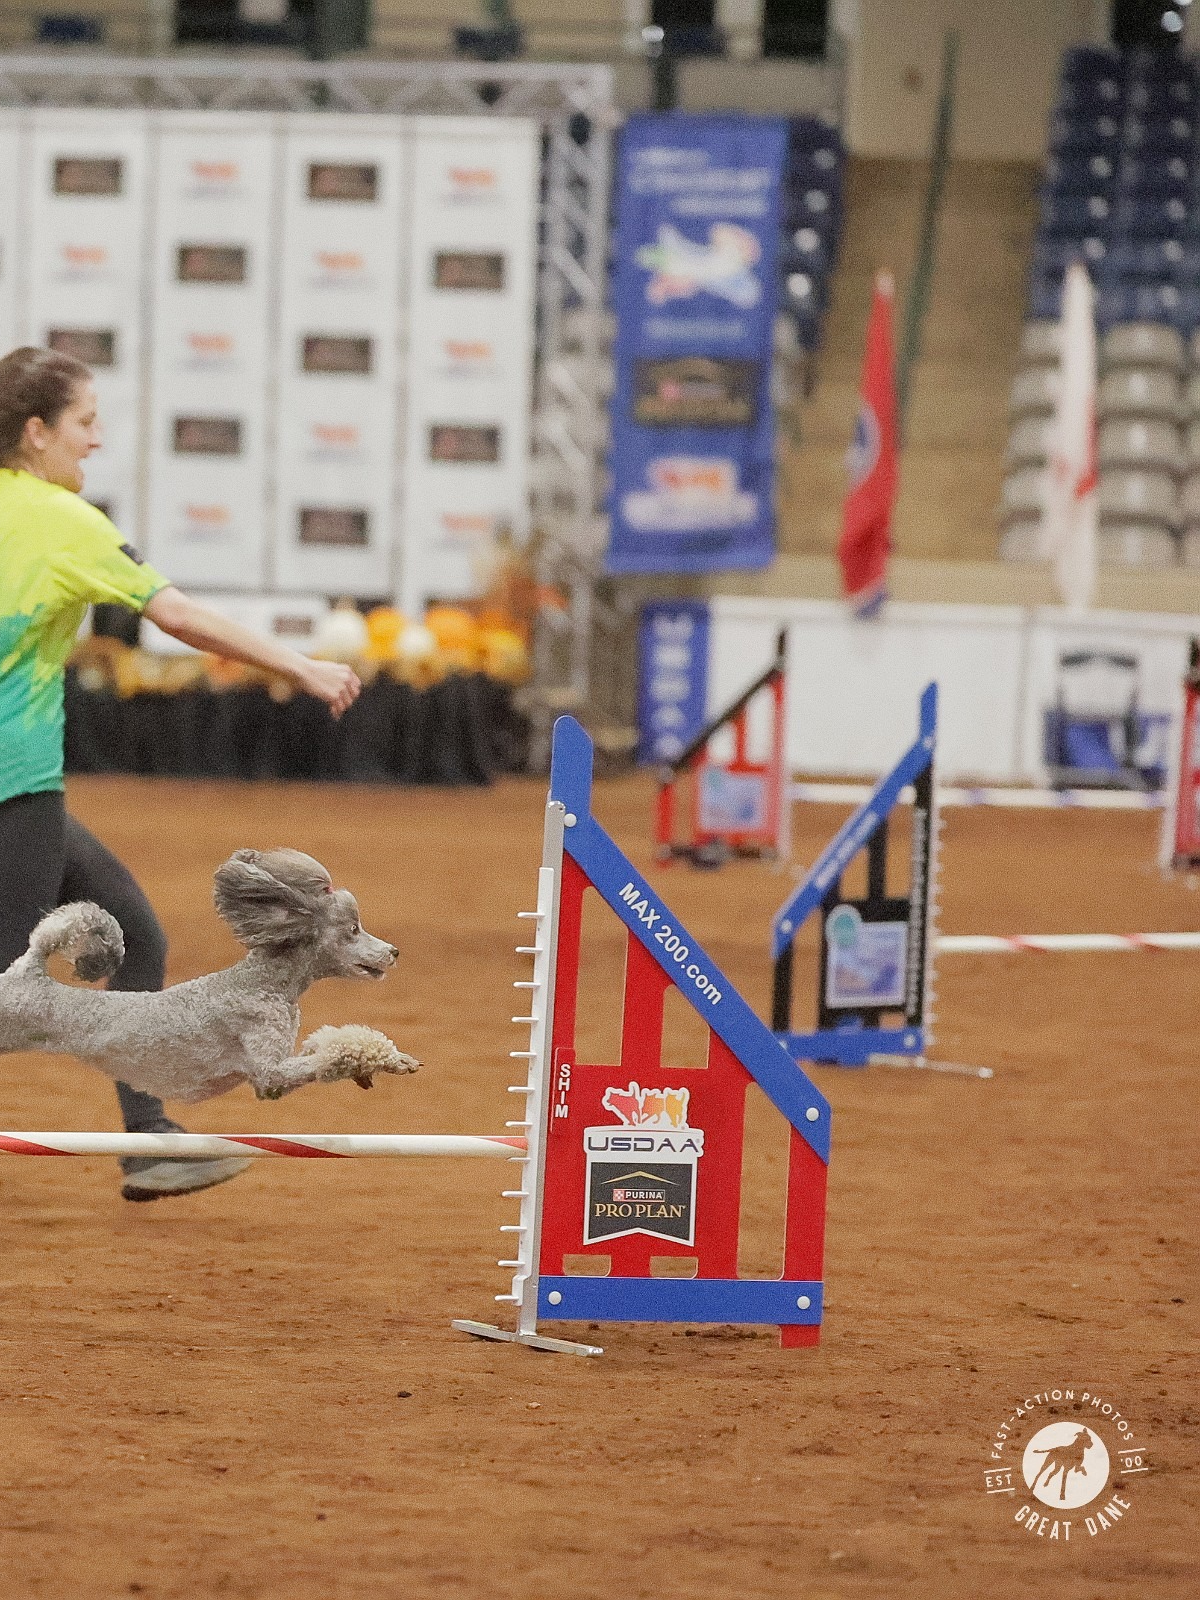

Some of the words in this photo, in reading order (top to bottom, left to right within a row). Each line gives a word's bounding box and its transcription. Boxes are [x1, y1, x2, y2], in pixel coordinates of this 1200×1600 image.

[618, 882, 661, 930] MAX
[654, 925, 722, 1006] 200.com
[554, 1063, 571, 1119] SHIM
[587, 1136, 699, 1153] USDAA
[625, 1190, 663, 1200] PURINA
[595, 1203, 632, 1218] PRO
[634, 1204, 683, 1218] PLAN
